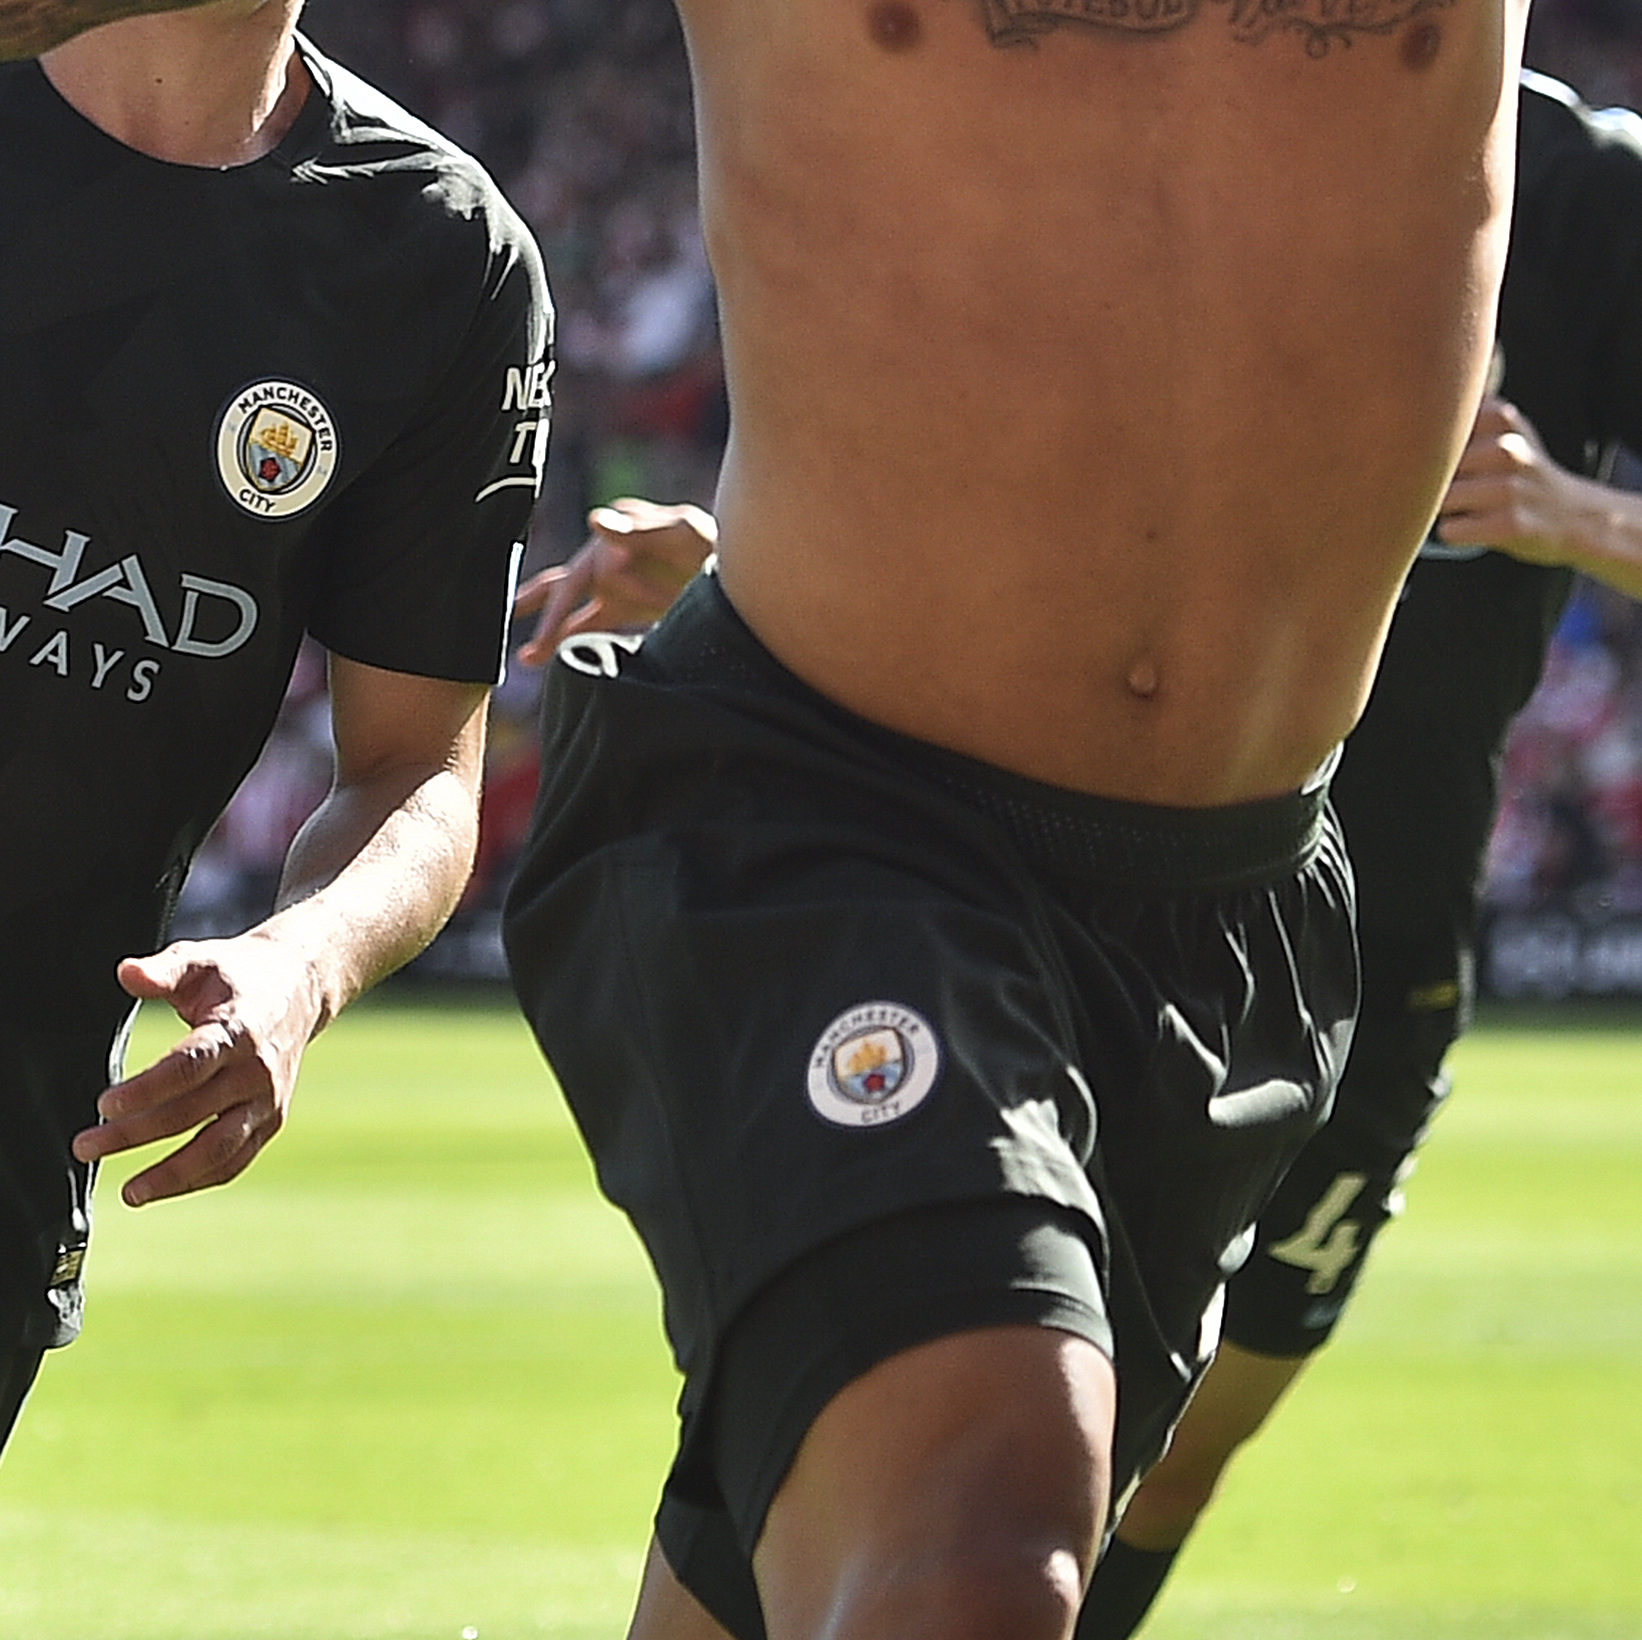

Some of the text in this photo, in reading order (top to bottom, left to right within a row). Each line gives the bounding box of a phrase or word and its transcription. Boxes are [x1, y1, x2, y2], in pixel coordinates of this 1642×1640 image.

[237, 386, 333, 452] MANCHESTER
[238, 488, 276, 513] CITY
[860, 1101, 901, 1124] CITY
